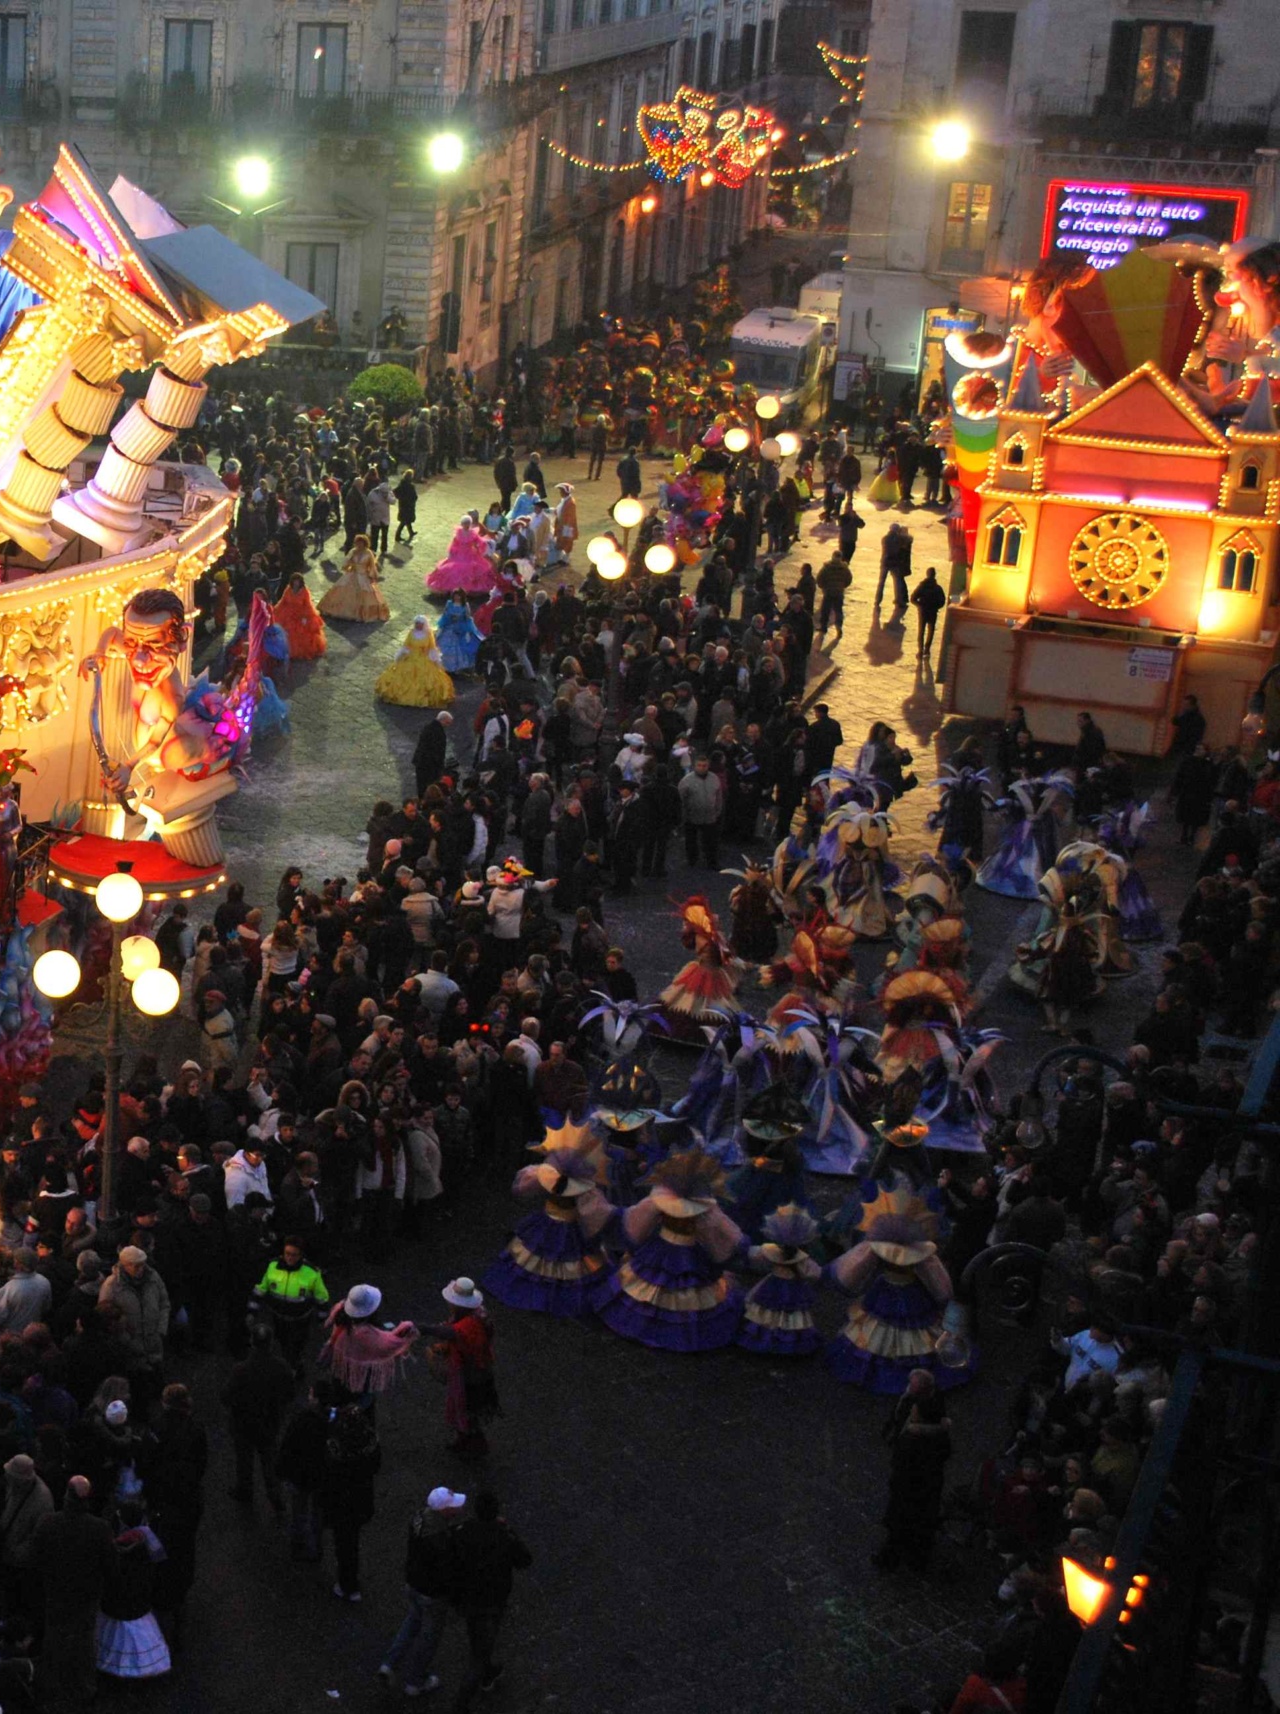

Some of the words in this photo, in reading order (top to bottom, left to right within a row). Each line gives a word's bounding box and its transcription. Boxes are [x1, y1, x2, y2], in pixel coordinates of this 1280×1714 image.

[1059, 198, 1132, 216] Acquista
[1136, 206, 1157, 217] un
[1161, 207, 1200, 220] auto
[1058, 220, 1068, 229] e
[1072, 219, 1145, 234] riceverai
[1147, 225, 1164, 236] in
[1056, 237, 1129, 253] omaggio
[1129, 665, 1137, 677] 8
